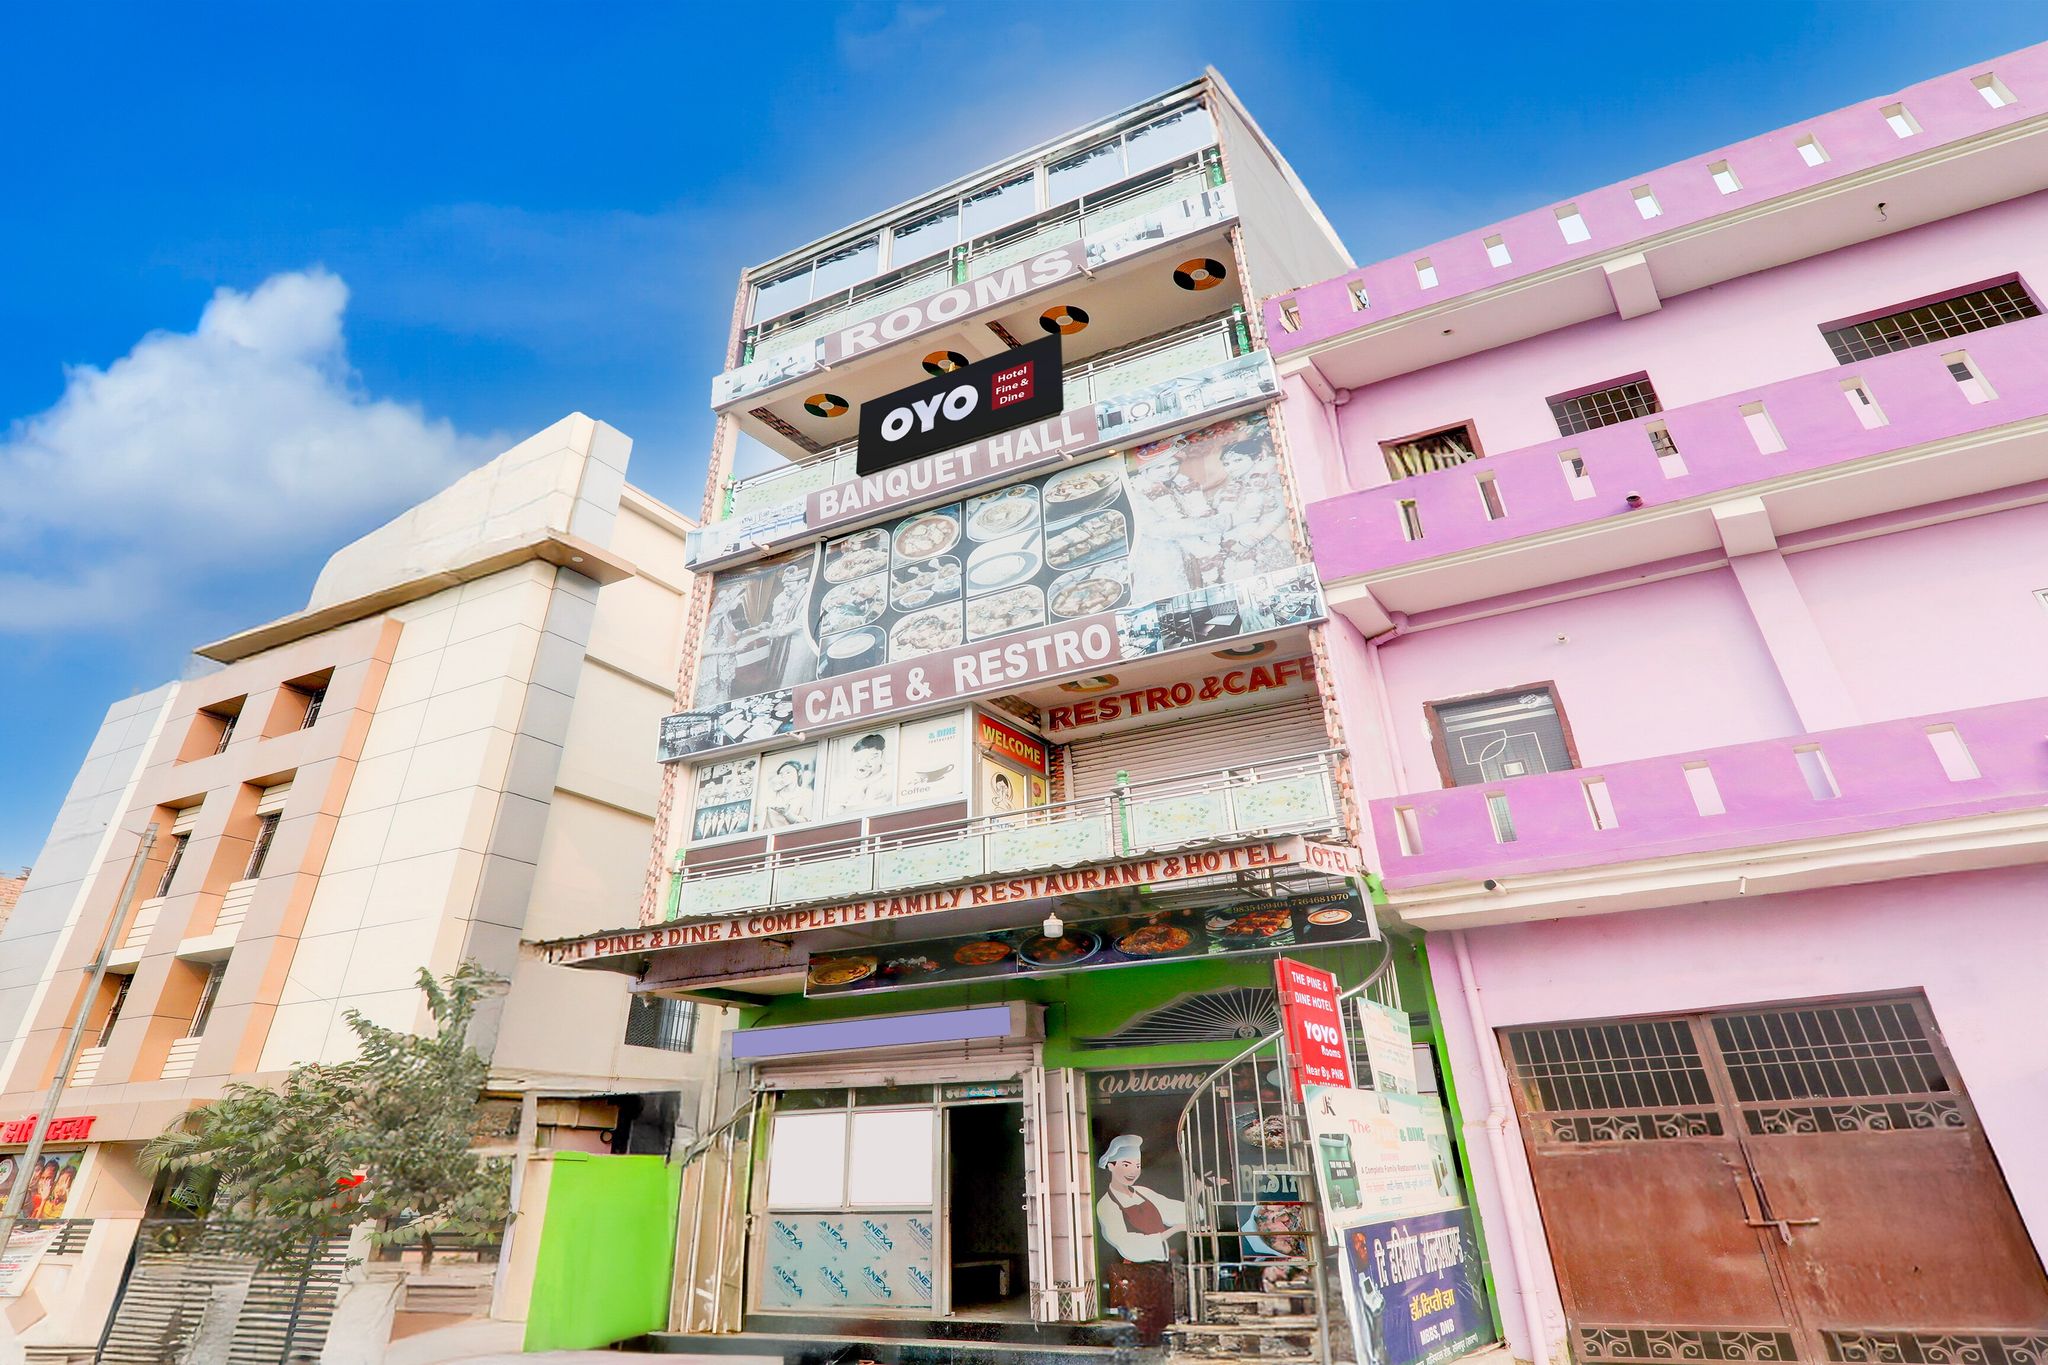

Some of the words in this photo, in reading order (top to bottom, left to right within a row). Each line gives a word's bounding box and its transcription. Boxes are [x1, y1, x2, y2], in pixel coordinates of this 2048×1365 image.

[840, 248, 1074, 357] ROOMS
[998, 366, 1027, 383] Hotel
[995, 383, 1018, 395] Fine
[1020, 378, 1029, 387] &
[1000, 391, 1025, 405] Dine
[881, 384, 979, 442] OYO
[819, 447, 978, 520] BANQUET
[988, 416, 1084, 467] HALL
[804, 674, 893, 724] CAFE
[905, 672, 931, 702] &
[953, 624, 1111, 693] RESTRO
[982, 723, 1041, 765] WELCOME
[901, 785, 931, 797] Coffee
[594, 933, 647, 956] PINE
[650, 930, 664, 948] &
[668, 923, 721, 947] DINE
[727, 920, 743, 939] A
[748, 903, 867, 934] COMPLETE
[874, 888, 963, 918] FAMILY
[1291, 971, 1306, 986] THE
[1306, 975, 1322, 989] PINE
[1323, 981, 1328, 992] &
[1294, 991, 1311, 1006] DINE
[1312, 996, 1333, 1012] HOTEL
[1304, 1020, 1339, 1045] YOYO
[1321, 1044, 1342, 1059] Rooms
[1305, 1063, 1320, 1078] Near
[1348, 1119, 1371, 1134] The
[863, 1219, 894, 1250] ANEXA
[863, 1266, 892, 1299] ANEXA
[1440, 1318, 1455, 1336] DNB
